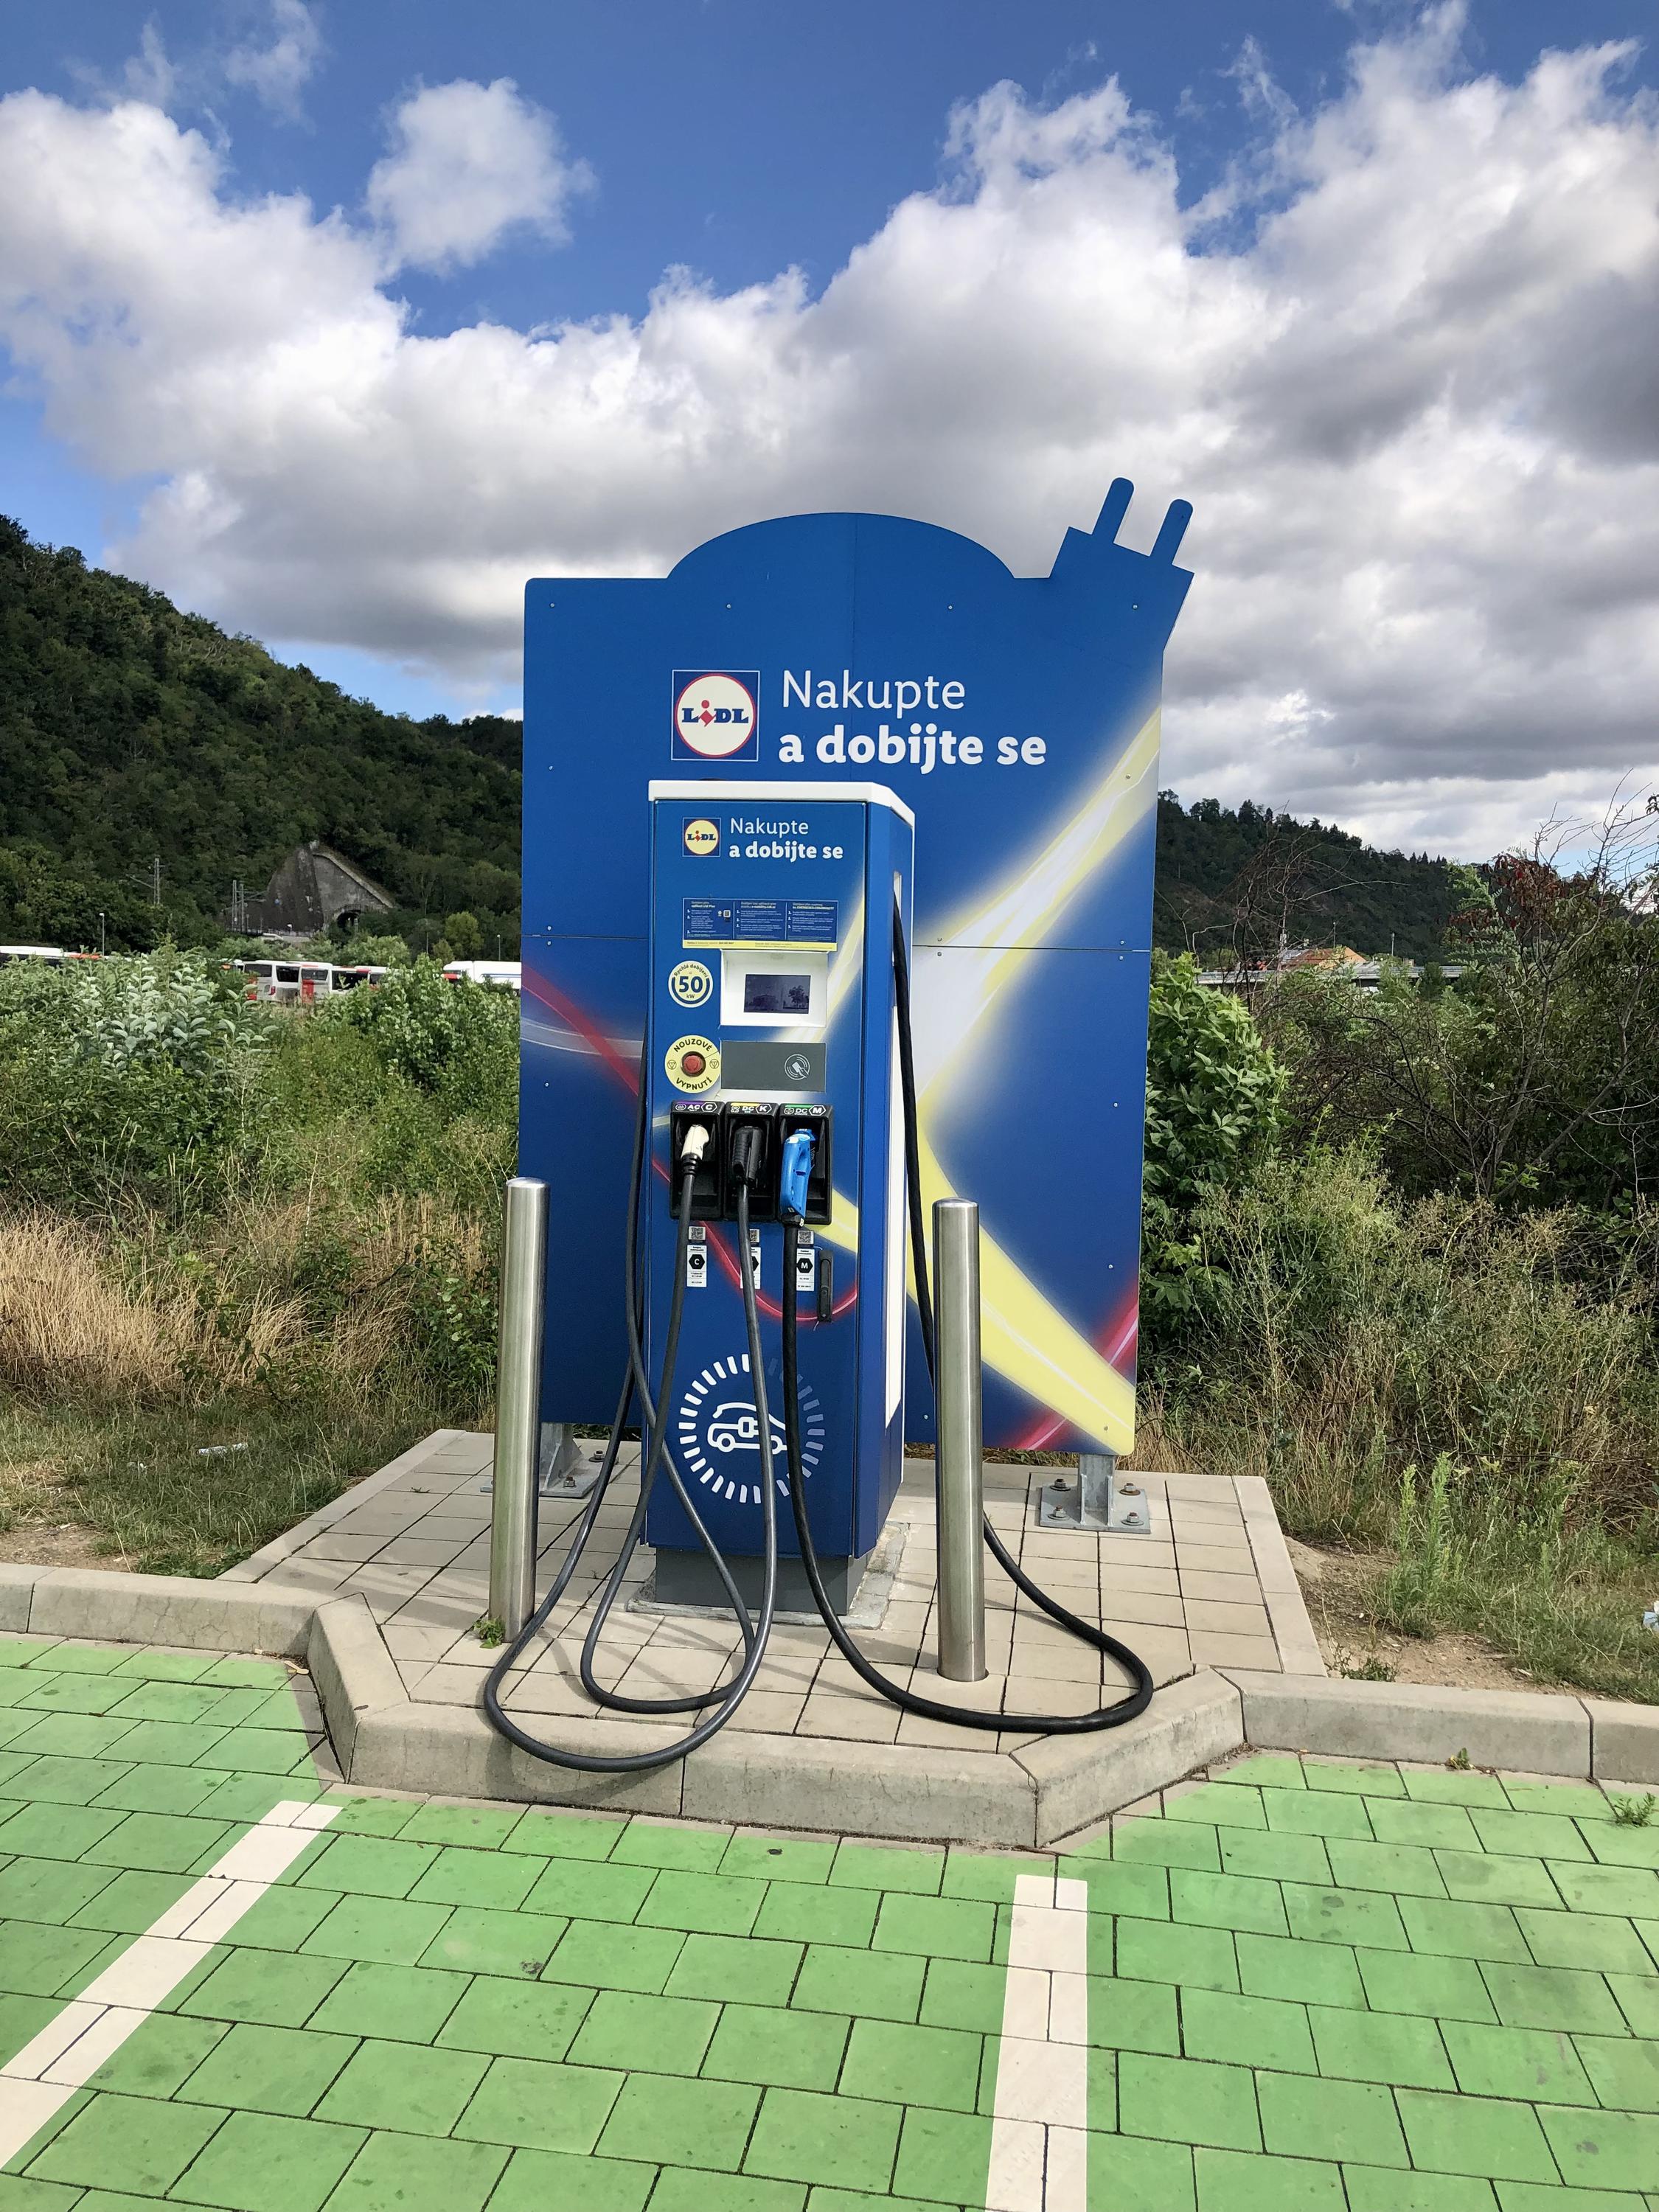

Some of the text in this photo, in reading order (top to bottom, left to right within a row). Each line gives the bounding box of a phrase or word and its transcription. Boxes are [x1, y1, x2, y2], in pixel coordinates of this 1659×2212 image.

[782, 669, 965, 718] Nakupte
[779, 724, 1046, 775] a dobijte se
[730, 818, 809, 838] Nakupte
[729, 842, 843, 863] a dobijte se
[674, 964, 689, 976] Rychlé
[679, 976, 703, 992] 50
[673, 1038, 712, 1053] NOUZOVÉ
[676, 1077, 712, 1090] VYPNUTÍ
